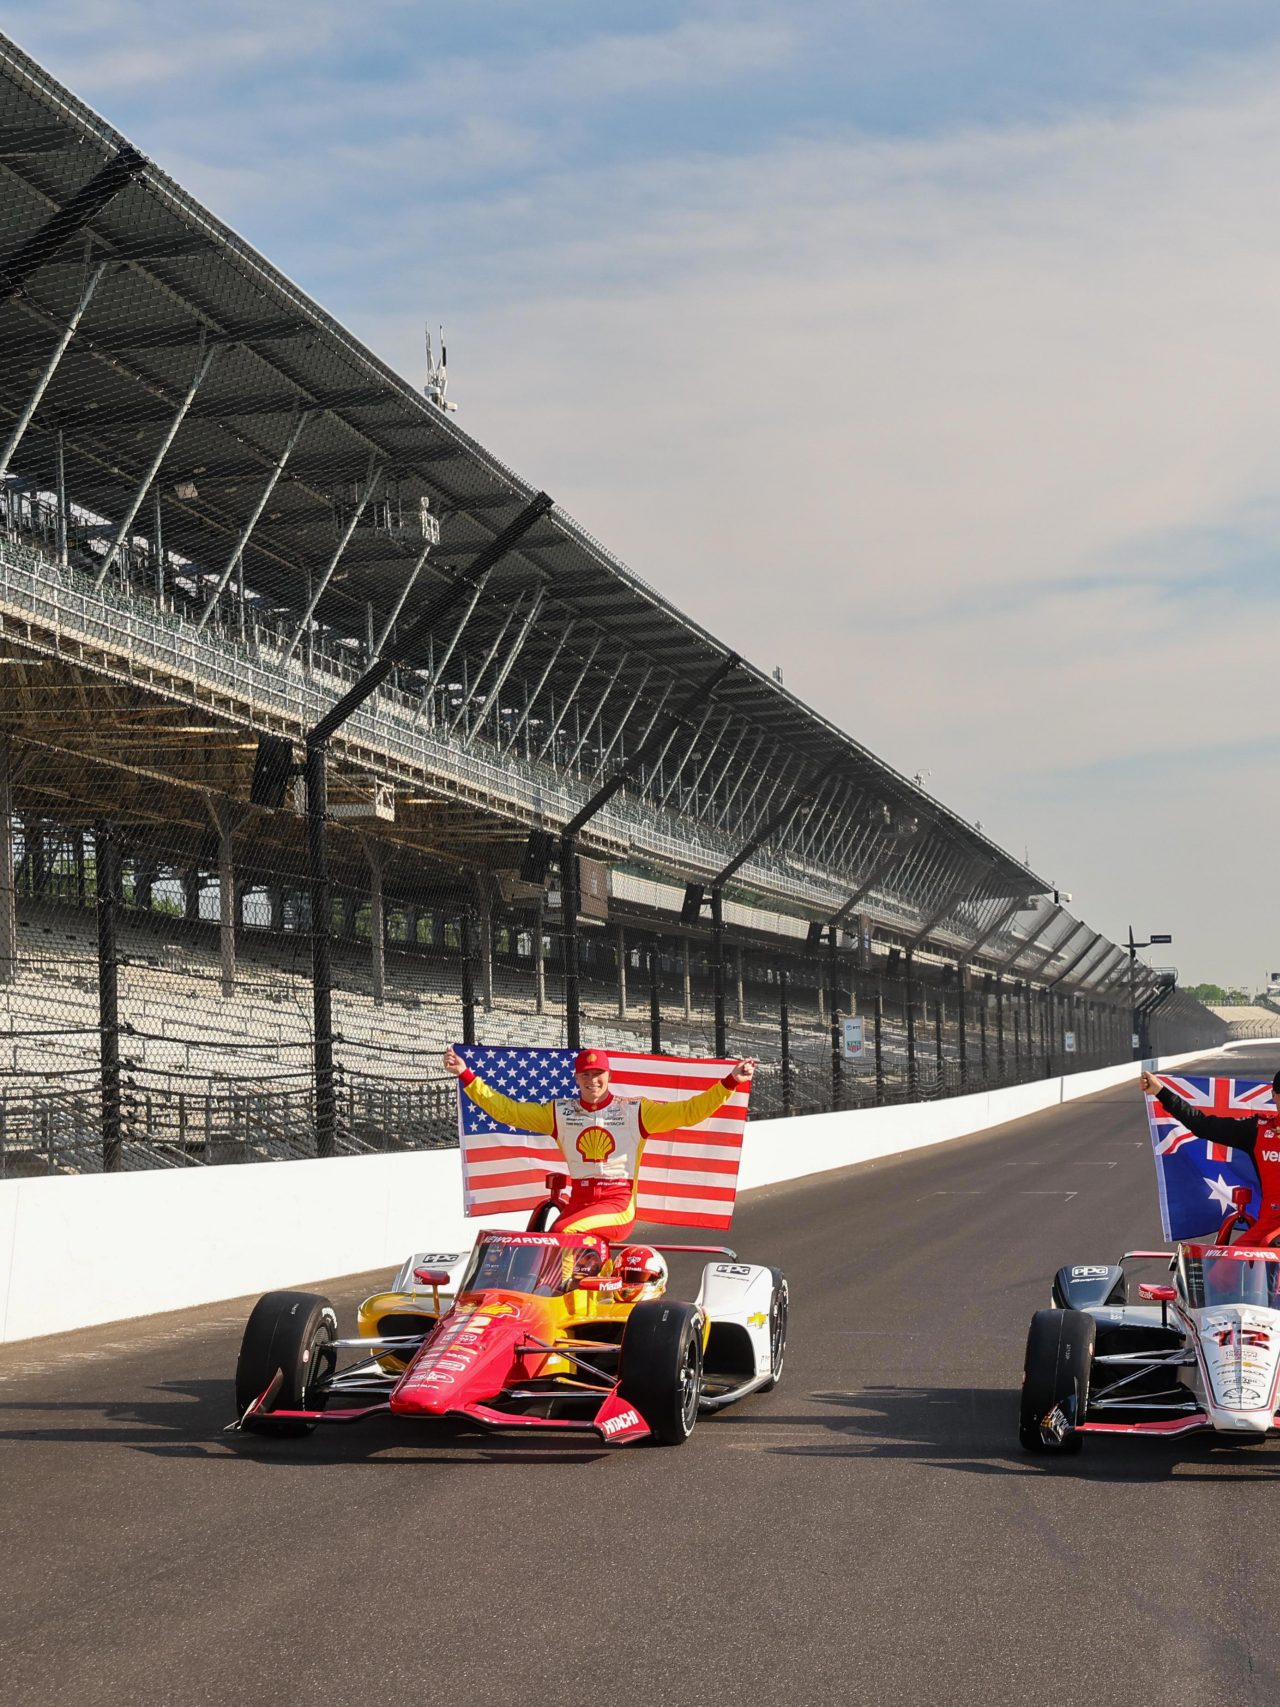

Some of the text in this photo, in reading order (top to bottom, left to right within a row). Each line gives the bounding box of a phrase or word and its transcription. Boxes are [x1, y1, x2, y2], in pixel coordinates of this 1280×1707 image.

[424, 1254, 458, 1262] PPG
[1234, 1250, 1278, 1260] POWER
[718, 1266, 750, 1275] PPG
[1074, 1267, 1108, 1277] PPG
[603, 1410, 639, 1434] HITACHI
